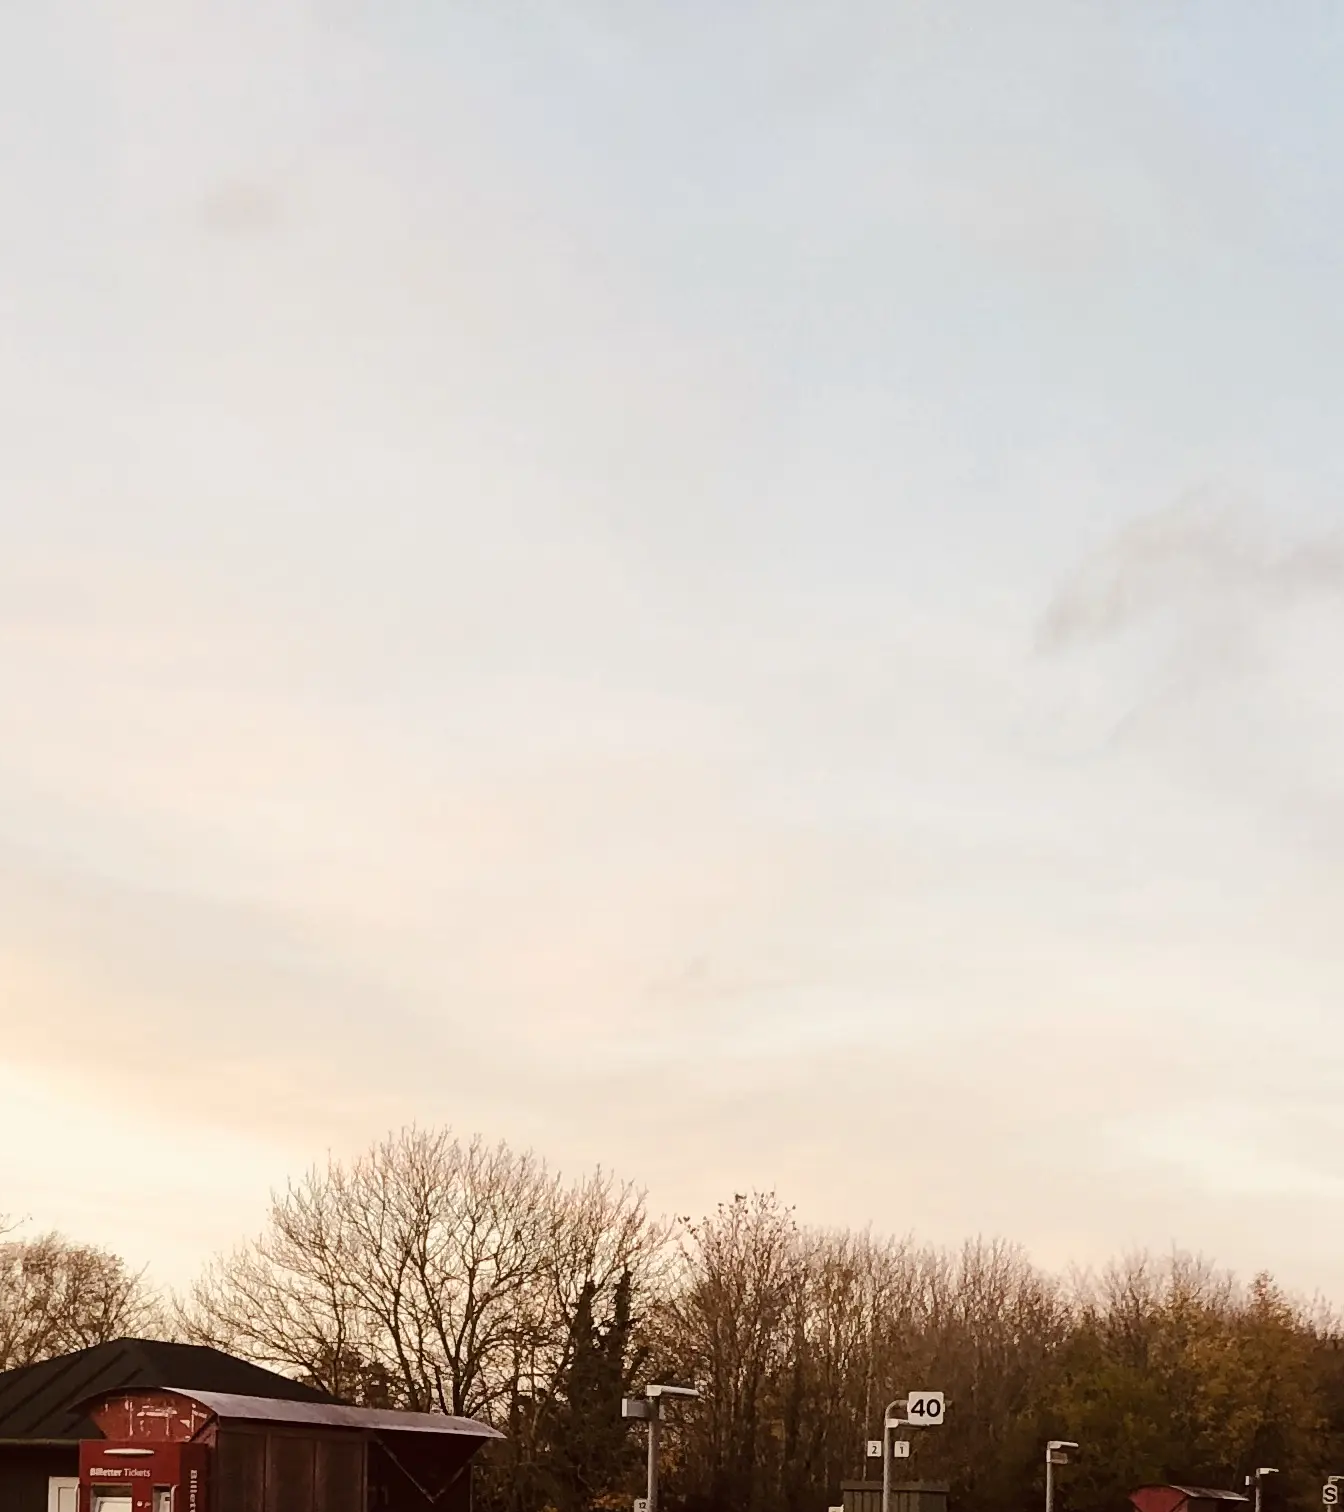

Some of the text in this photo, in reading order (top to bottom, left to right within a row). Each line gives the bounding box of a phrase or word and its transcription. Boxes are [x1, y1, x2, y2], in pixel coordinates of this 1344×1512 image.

[910, 1398, 941, 1418] 40
[871, 1445, 877, 1454] 2
[123, 1467, 151, 1478] Tickets
[1324, 1486, 1336, 1502] S
